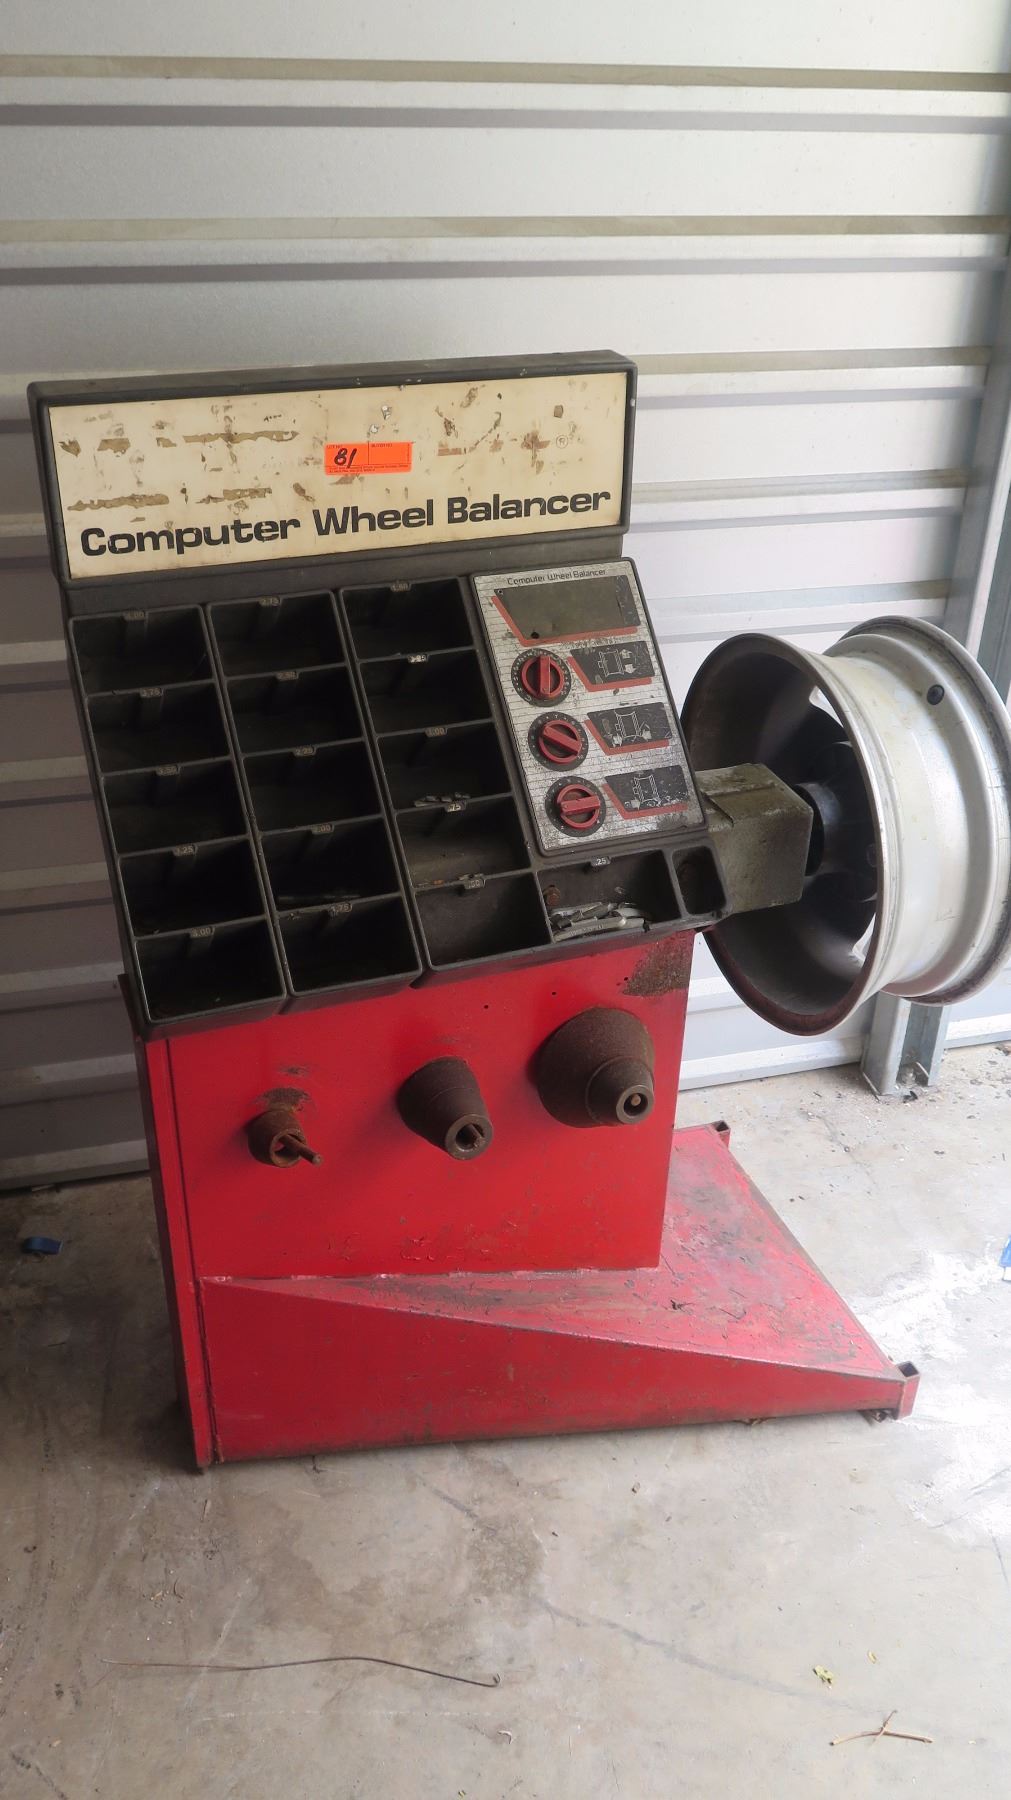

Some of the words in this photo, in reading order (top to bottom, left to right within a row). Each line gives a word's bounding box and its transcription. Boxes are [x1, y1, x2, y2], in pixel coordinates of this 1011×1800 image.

[334, 448, 357, 468] 81
[80, 518, 300, 556] Computer
[312, 499, 433, 536] Wheel
[448, 490, 611, 524] Balancer
[507, 575, 545, 585] Computer
[547, 571, 572, 581] Wheel
[573, 568, 606, 579] Balancer
